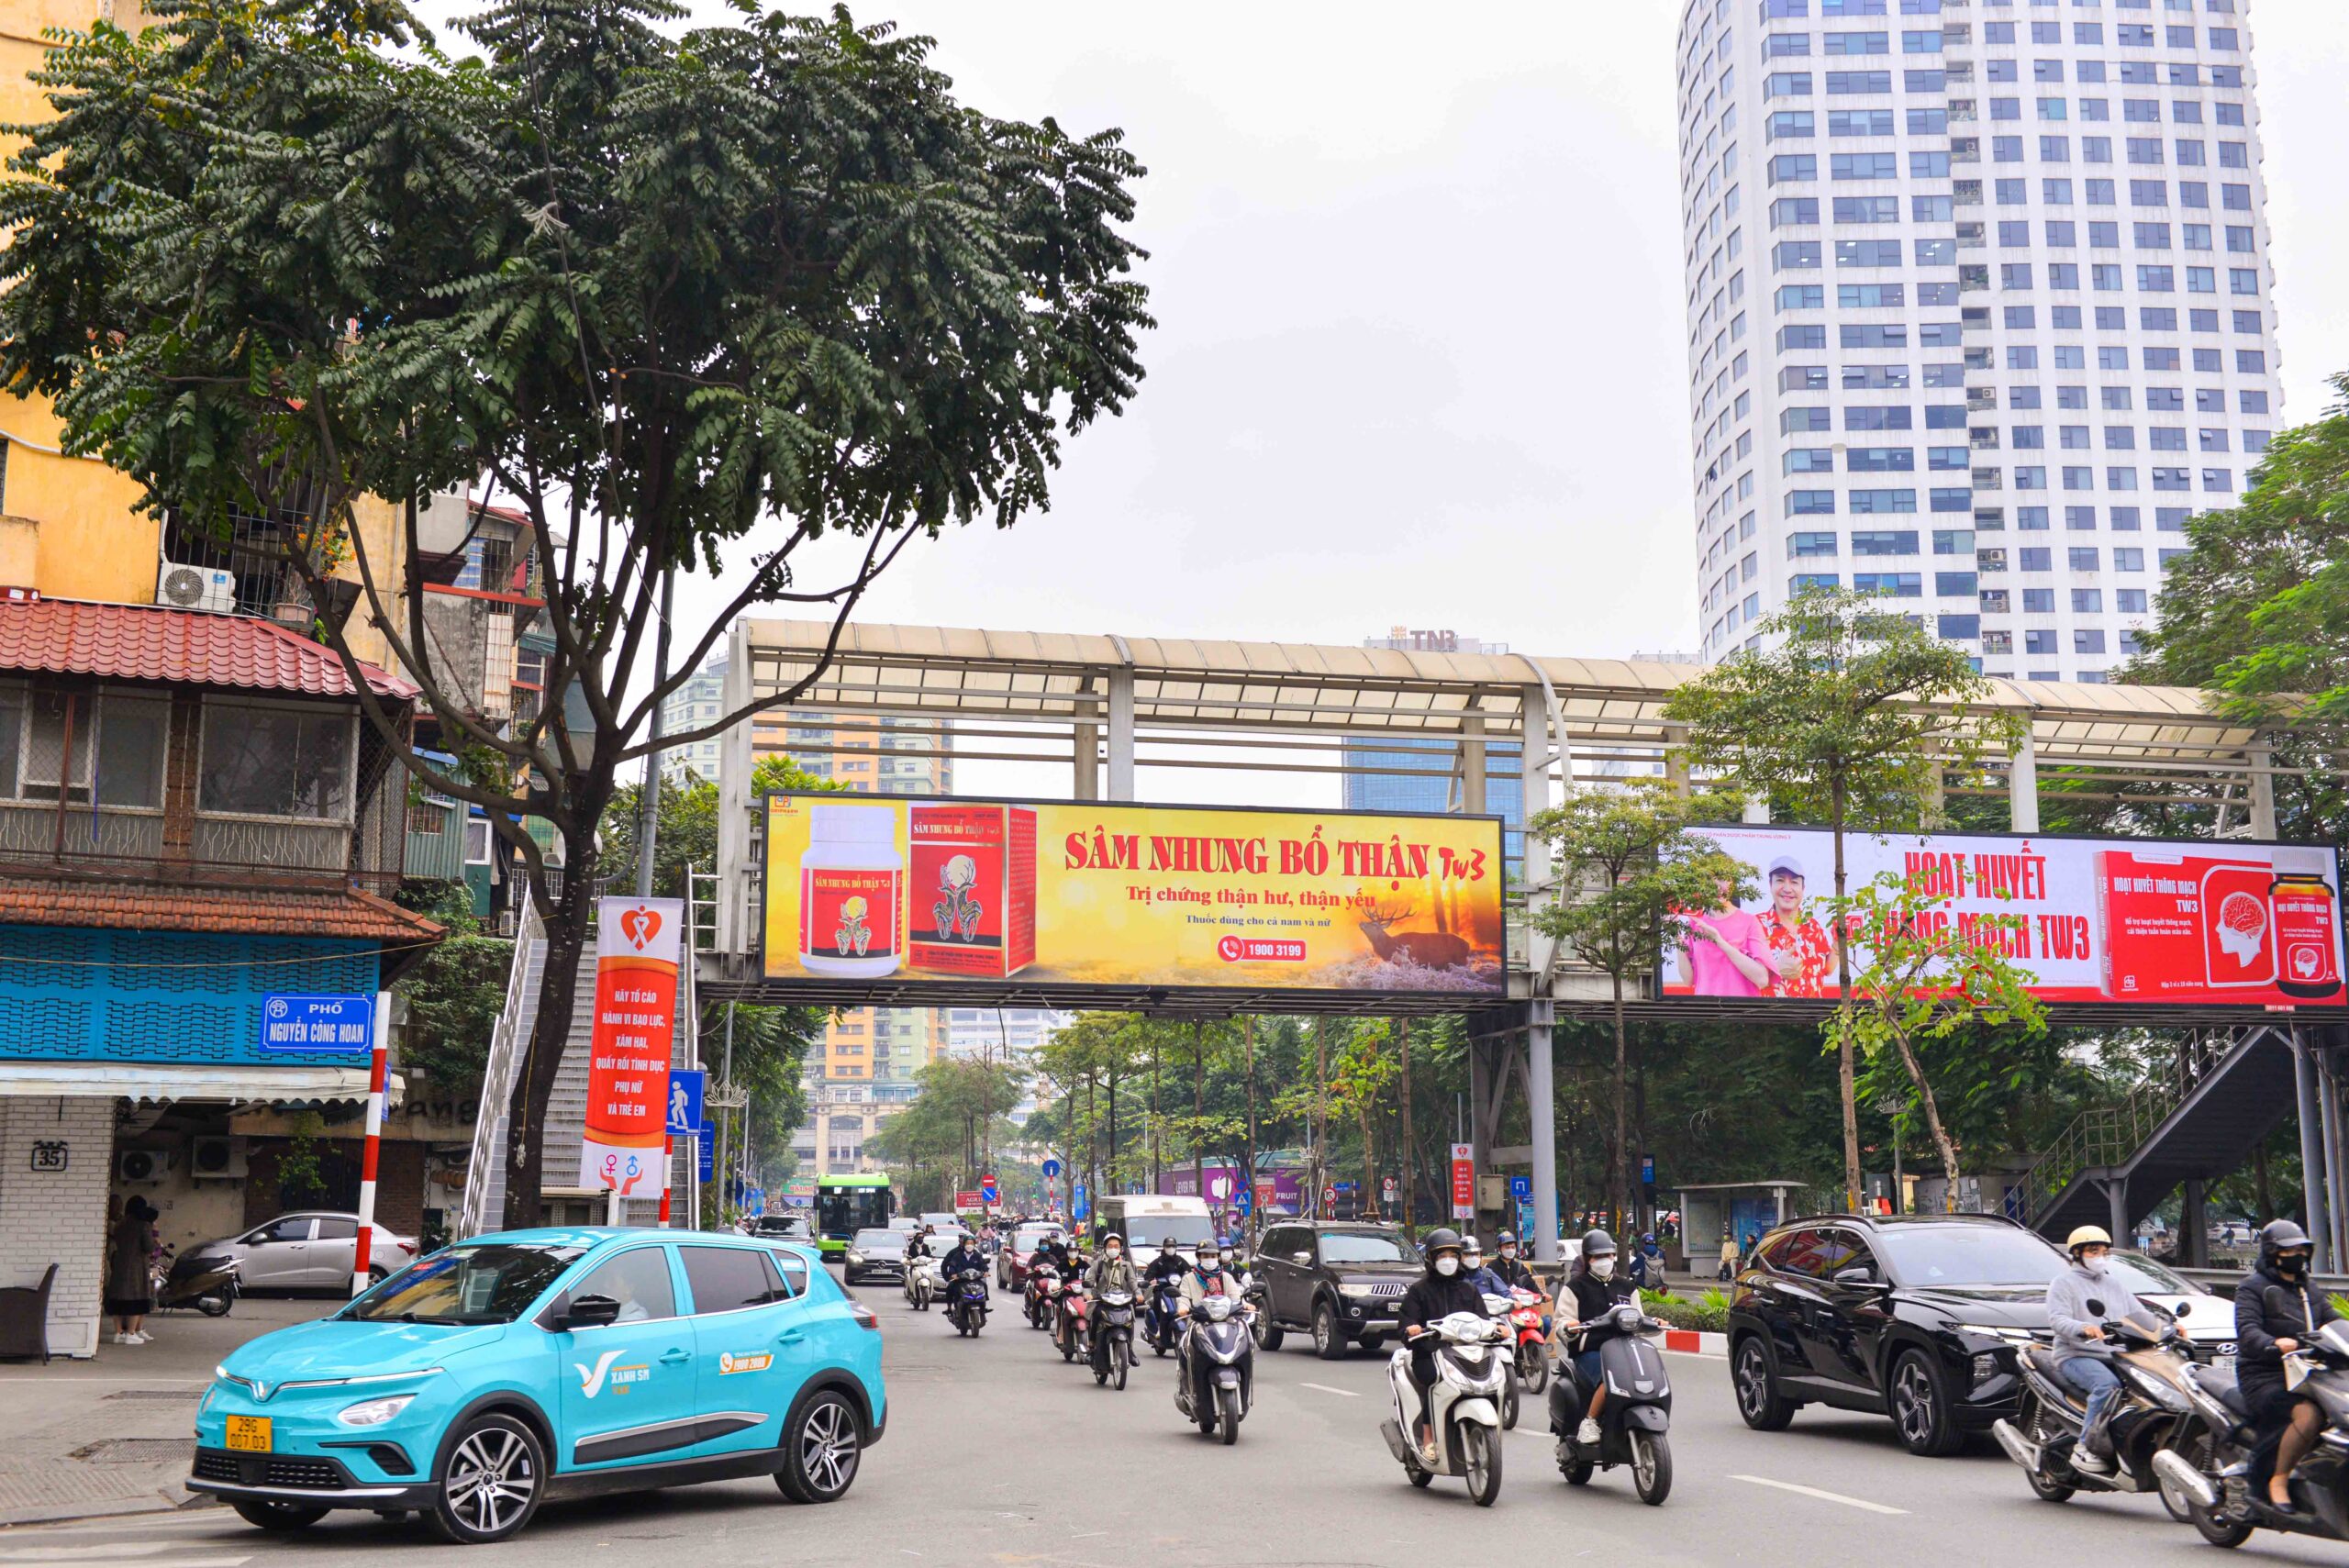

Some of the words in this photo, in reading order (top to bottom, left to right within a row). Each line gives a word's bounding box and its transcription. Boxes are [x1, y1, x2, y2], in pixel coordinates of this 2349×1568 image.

[1065, 824, 1141, 871] SÂM
[1148, 835, 1270, 874] NHUNG
[1278, 824, 1329, 876] BỔ
[1337, 834, 1431, 891] THẬN
[1904, 851, 1965, 908] HOẠT
[1974, 840, 2046, 900] HUYẾT
[2113, 877, 2132, 895] HOẠT
[2133, 873, 2154, 894] HUYẾT
[2155, 876, 2176, 895] THÔNG
[2177, 881, 2198, 898] MẠCH
[1126, 885, 1151, 906] Trị
[1156, 886, 1211, 906] chứng
[1217, 888, 1258, 908] thận
[1264, 890, 1295, 907] hư,
[1299, 890, 1340, 910] thận
[1345, 887, 1375, 910] yếu
[2176, 899, 2199, 914] TW3
[1186, 912, 1217, 924] Thuốc
[1219, 916, 1244, 927] dùng
[1246, 916, 1264, 926] cho
[1266, 916, 1277, 926] cả
[1281, 918, 1301, 927] nam
[1304, 917, 1315, 927] và
[1317, 917, 1330, 927] nữ
[1869, 906, 1949, 958] THNG
[2037, 914, 2090, 961] TW3
[1249, 944, 1274, 956] 1900
[1276, 944, 1301, 956] 3199
[630, 987, 640, 1003] TỐ
[641, 989, 657, 1004] CÁO
[308, 1000, 344, 1014] PHỐ
[602, 1010, 623, 1025] HÀNH
[624, 1013, 631, 1025] VI
[632, 1014, 648, 1028] BẠO
[649, 1014, 665, 1029] LỰC,
[310, 1018, 336, 1043] CÔNG
[339, 1023, 365, 1043] HOAN
[633, 1036, 649, 1051] HẠI,
[596, 1054, 616, 1070] QUẤY
[617, 1055, 629, 1070] RỐI
[630, 1057, 648, 1071] TÌNH
[649, 1060, 665, 1074] DỤC
[615, 1081, 629, 1095] PHỤ
[630, 1080, 643, 1094] NỮ
[607, 1101, 617, 1116] VÀ
[618, 1100, 631, 1117] TRẺ
[633, 1105, 646, 1117] EM
[39, 1150, 61, 1166] 35
[1275, 1192, 1297, 1200] FRUIT
[611, 1370, 635, 1384] XANH
[637, 1368, 650, 1382] SM
